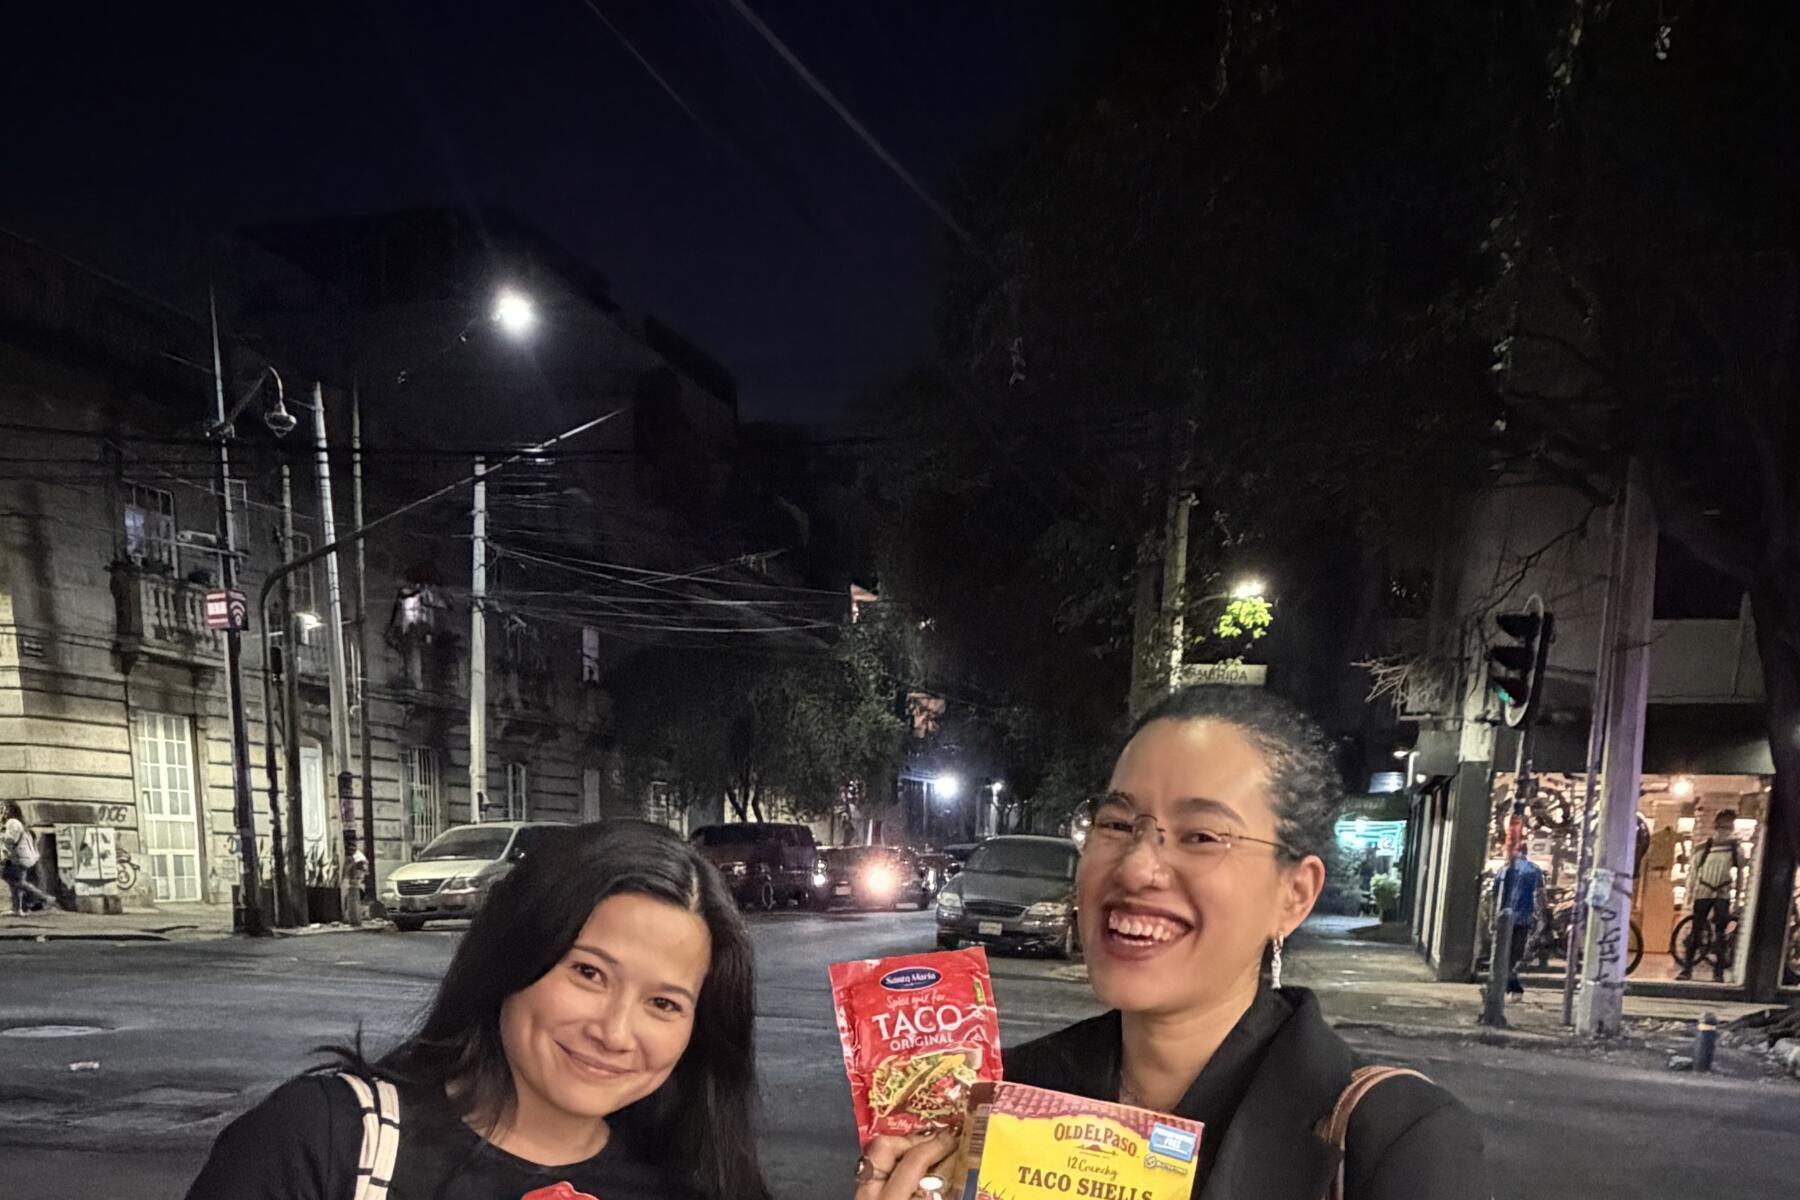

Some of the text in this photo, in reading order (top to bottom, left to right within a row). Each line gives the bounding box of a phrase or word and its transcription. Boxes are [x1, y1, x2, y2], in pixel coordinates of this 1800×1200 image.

[885, 975, 910, 985] Santa
[872, 1005, 962, 1040] TACO
[890, 1033, 954, 1051] ORIGINAL
[1054, 1122, 1083, 1142] OLD
[1084, 1123, 1102, 1142] EL
[1018, 1166, 1072, 1192] TACO
[1067, 1156, 1118, 1181] 12 Crunchy
